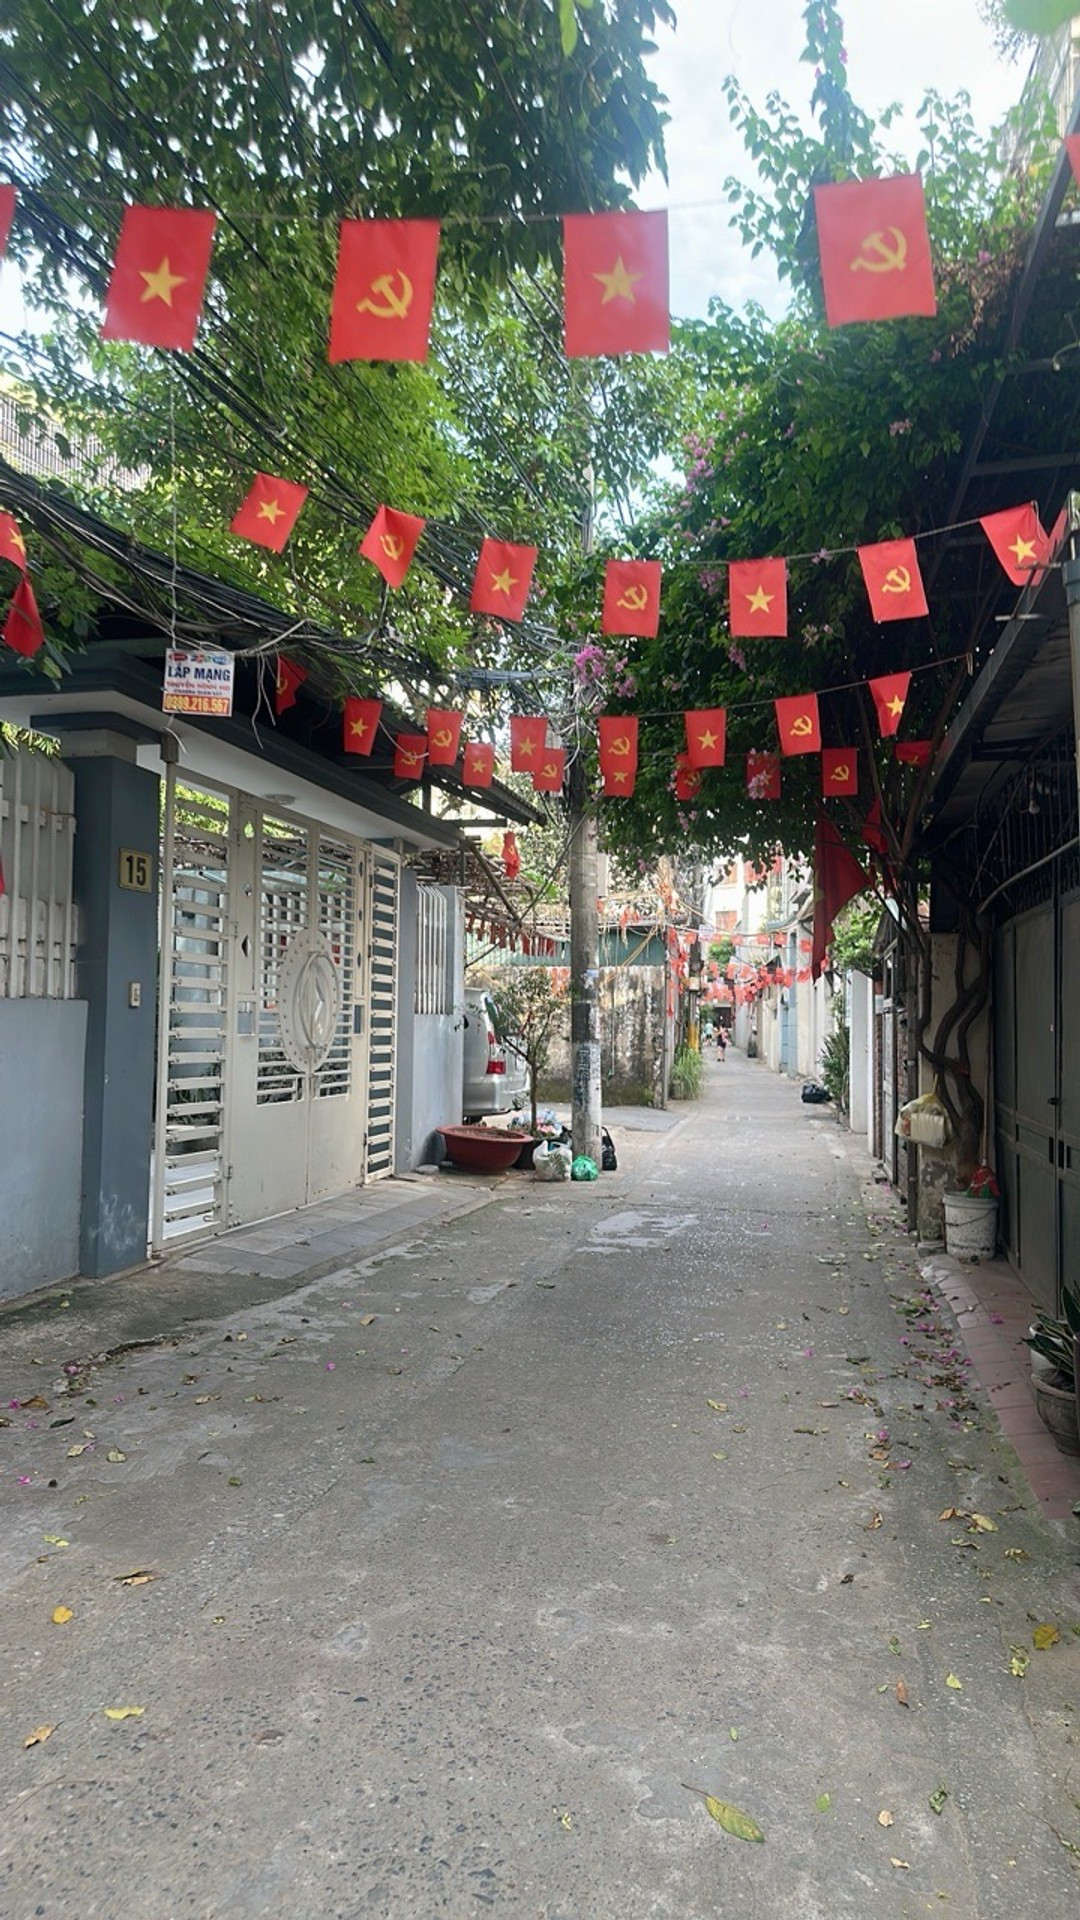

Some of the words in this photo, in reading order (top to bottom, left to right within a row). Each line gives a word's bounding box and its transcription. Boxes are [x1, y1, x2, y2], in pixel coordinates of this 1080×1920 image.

[168, 663, 191, 678] LẮP
[193, 667, 231, 683] MẠNG
[126, 855, 147, 886] 15
